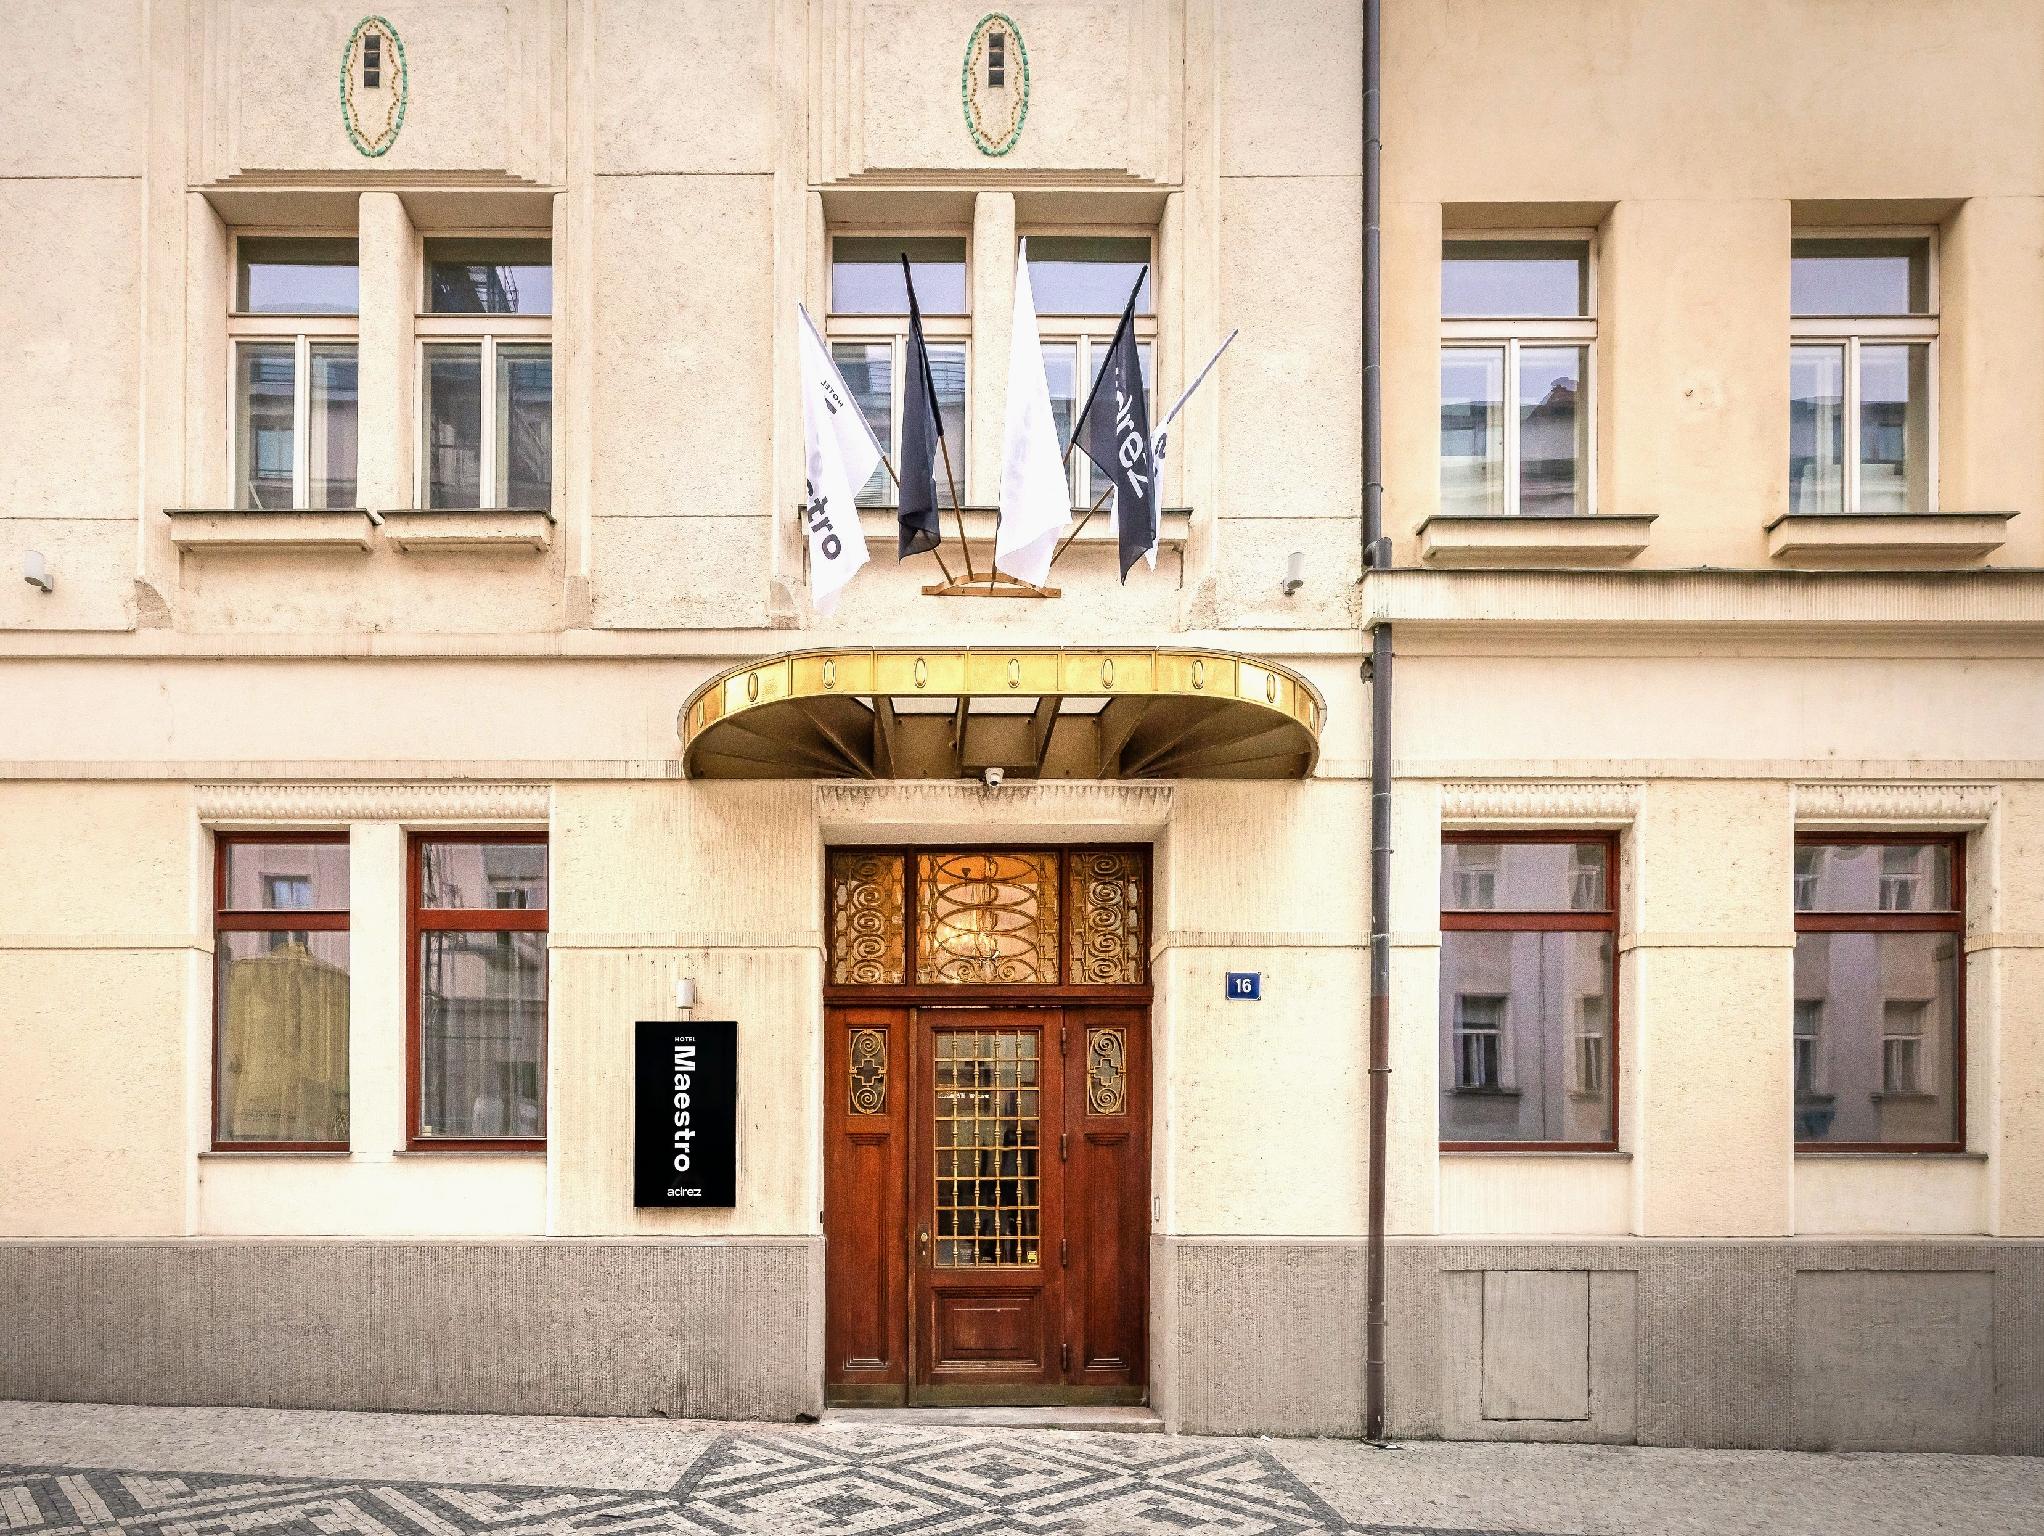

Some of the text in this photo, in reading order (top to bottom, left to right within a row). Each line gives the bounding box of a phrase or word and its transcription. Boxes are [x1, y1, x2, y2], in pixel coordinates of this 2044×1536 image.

[1235, 978, 1252, 993] 16
[674, 1045, 696, 1172] Maestro
[667, 1186, 702, 1197] adrez
